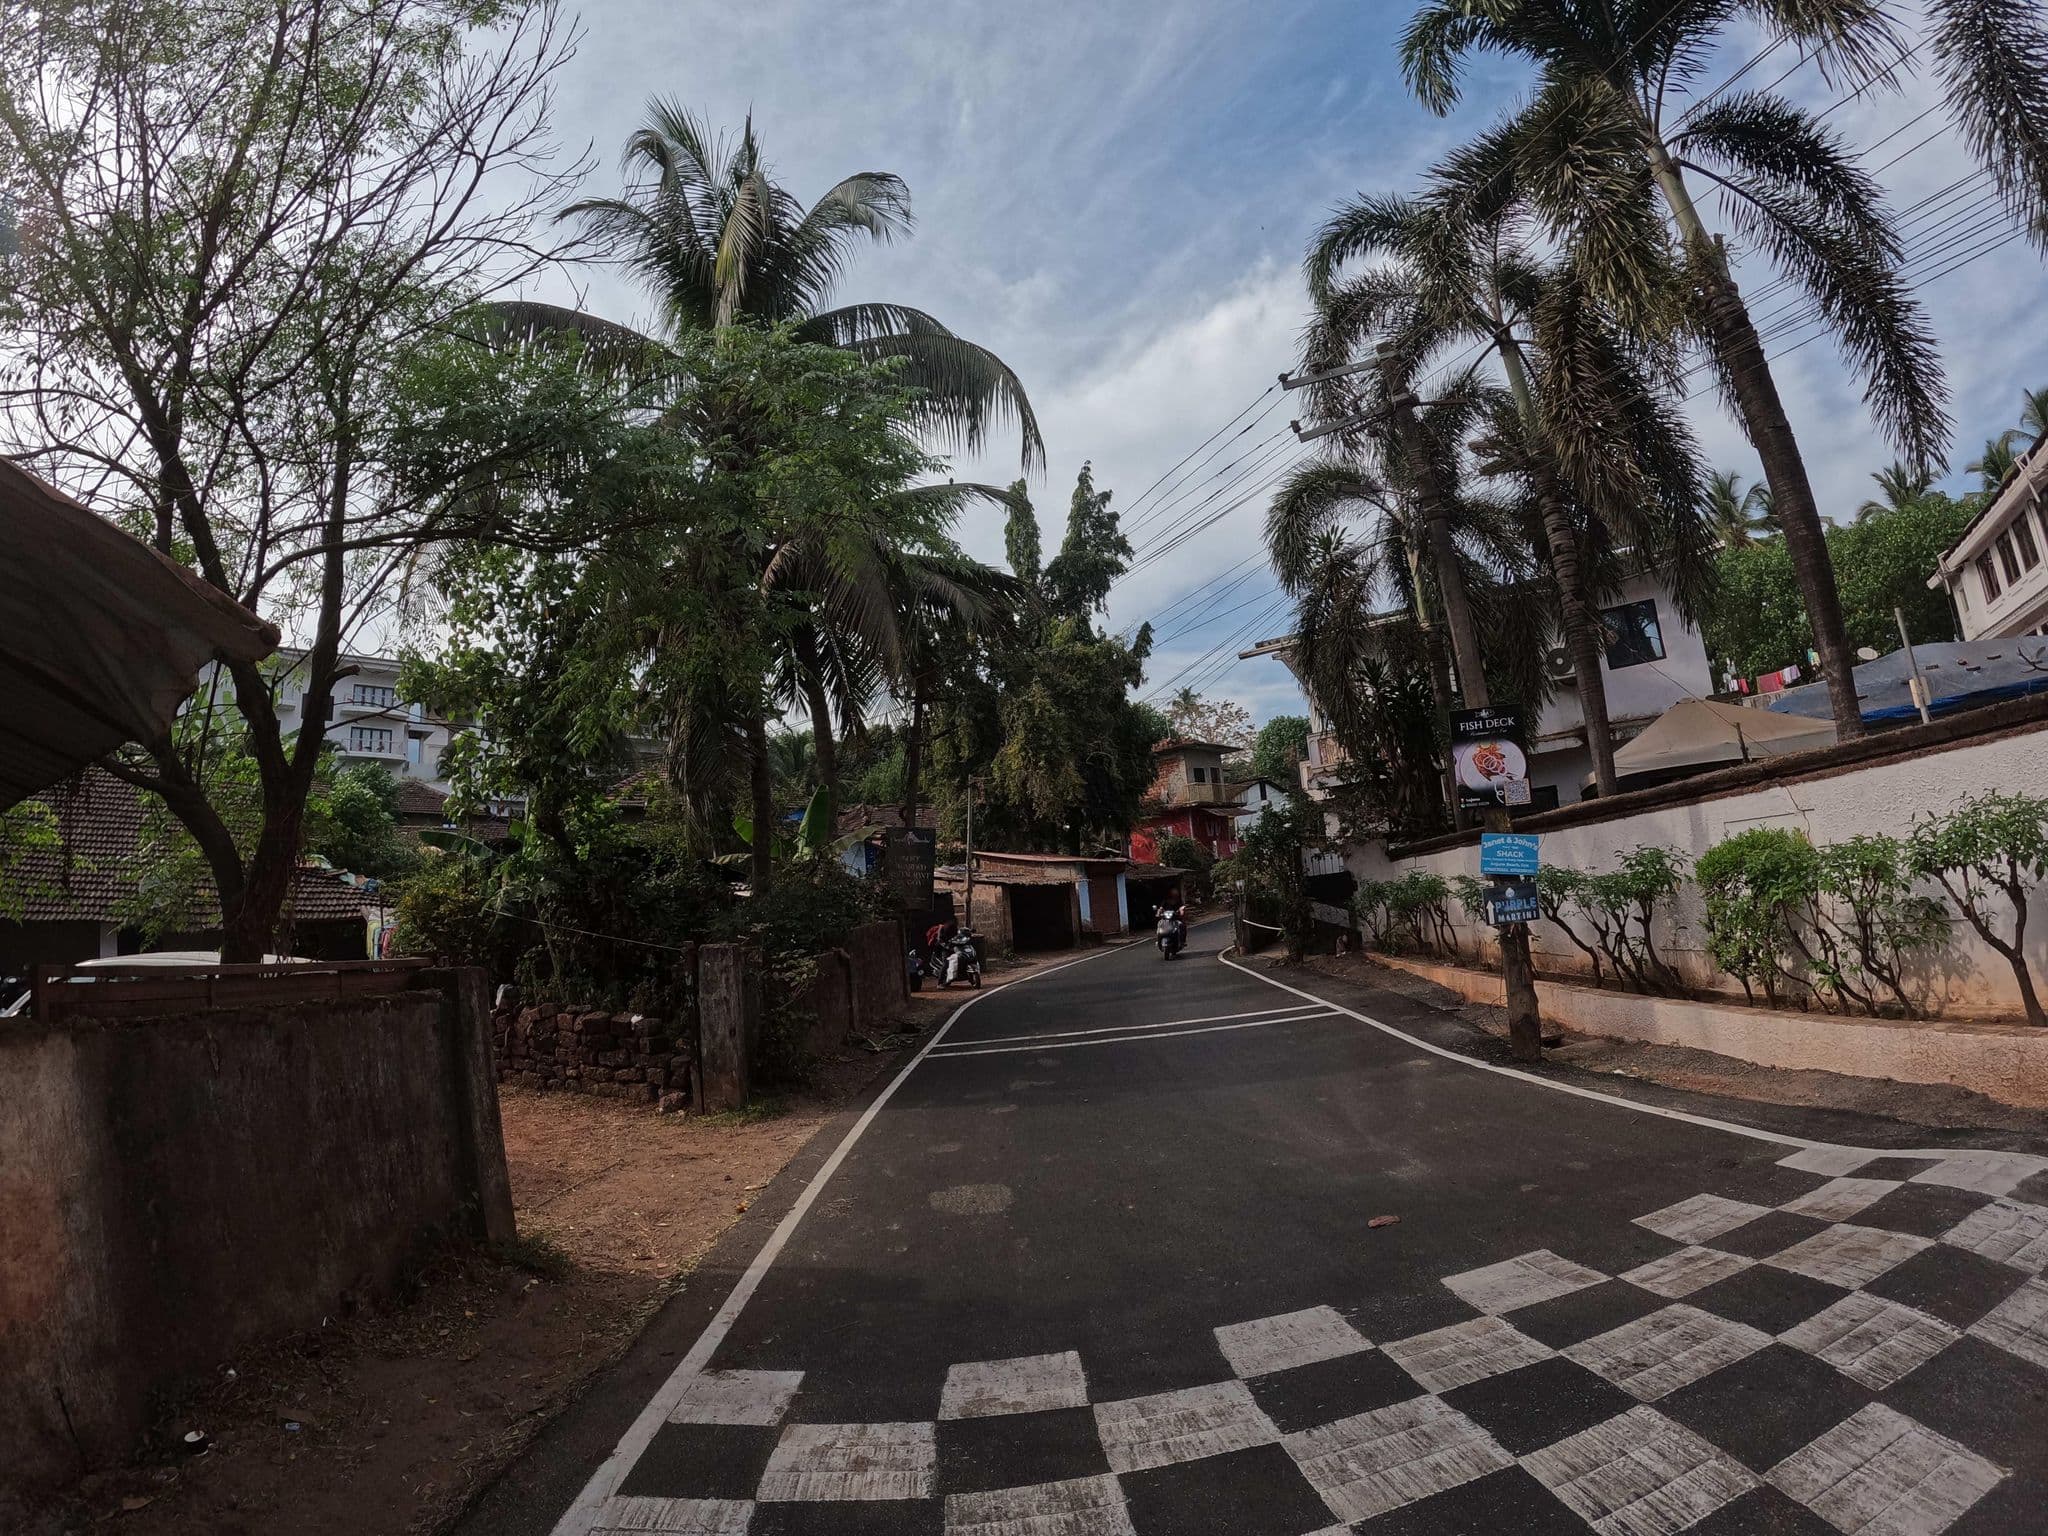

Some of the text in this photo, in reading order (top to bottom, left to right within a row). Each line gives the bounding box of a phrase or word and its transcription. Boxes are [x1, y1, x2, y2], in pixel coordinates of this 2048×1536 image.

[1459, 717, 1515, 732] FISH DECK
[1483, 837, 1505, 849] Janet
[1506, 836, 1512, 844] &
[1496, 850, 1524, 858] SHACK
[1495, 896, 1537, 913] PURPLE
[1498, 910, 1537, 923] MARTINI
